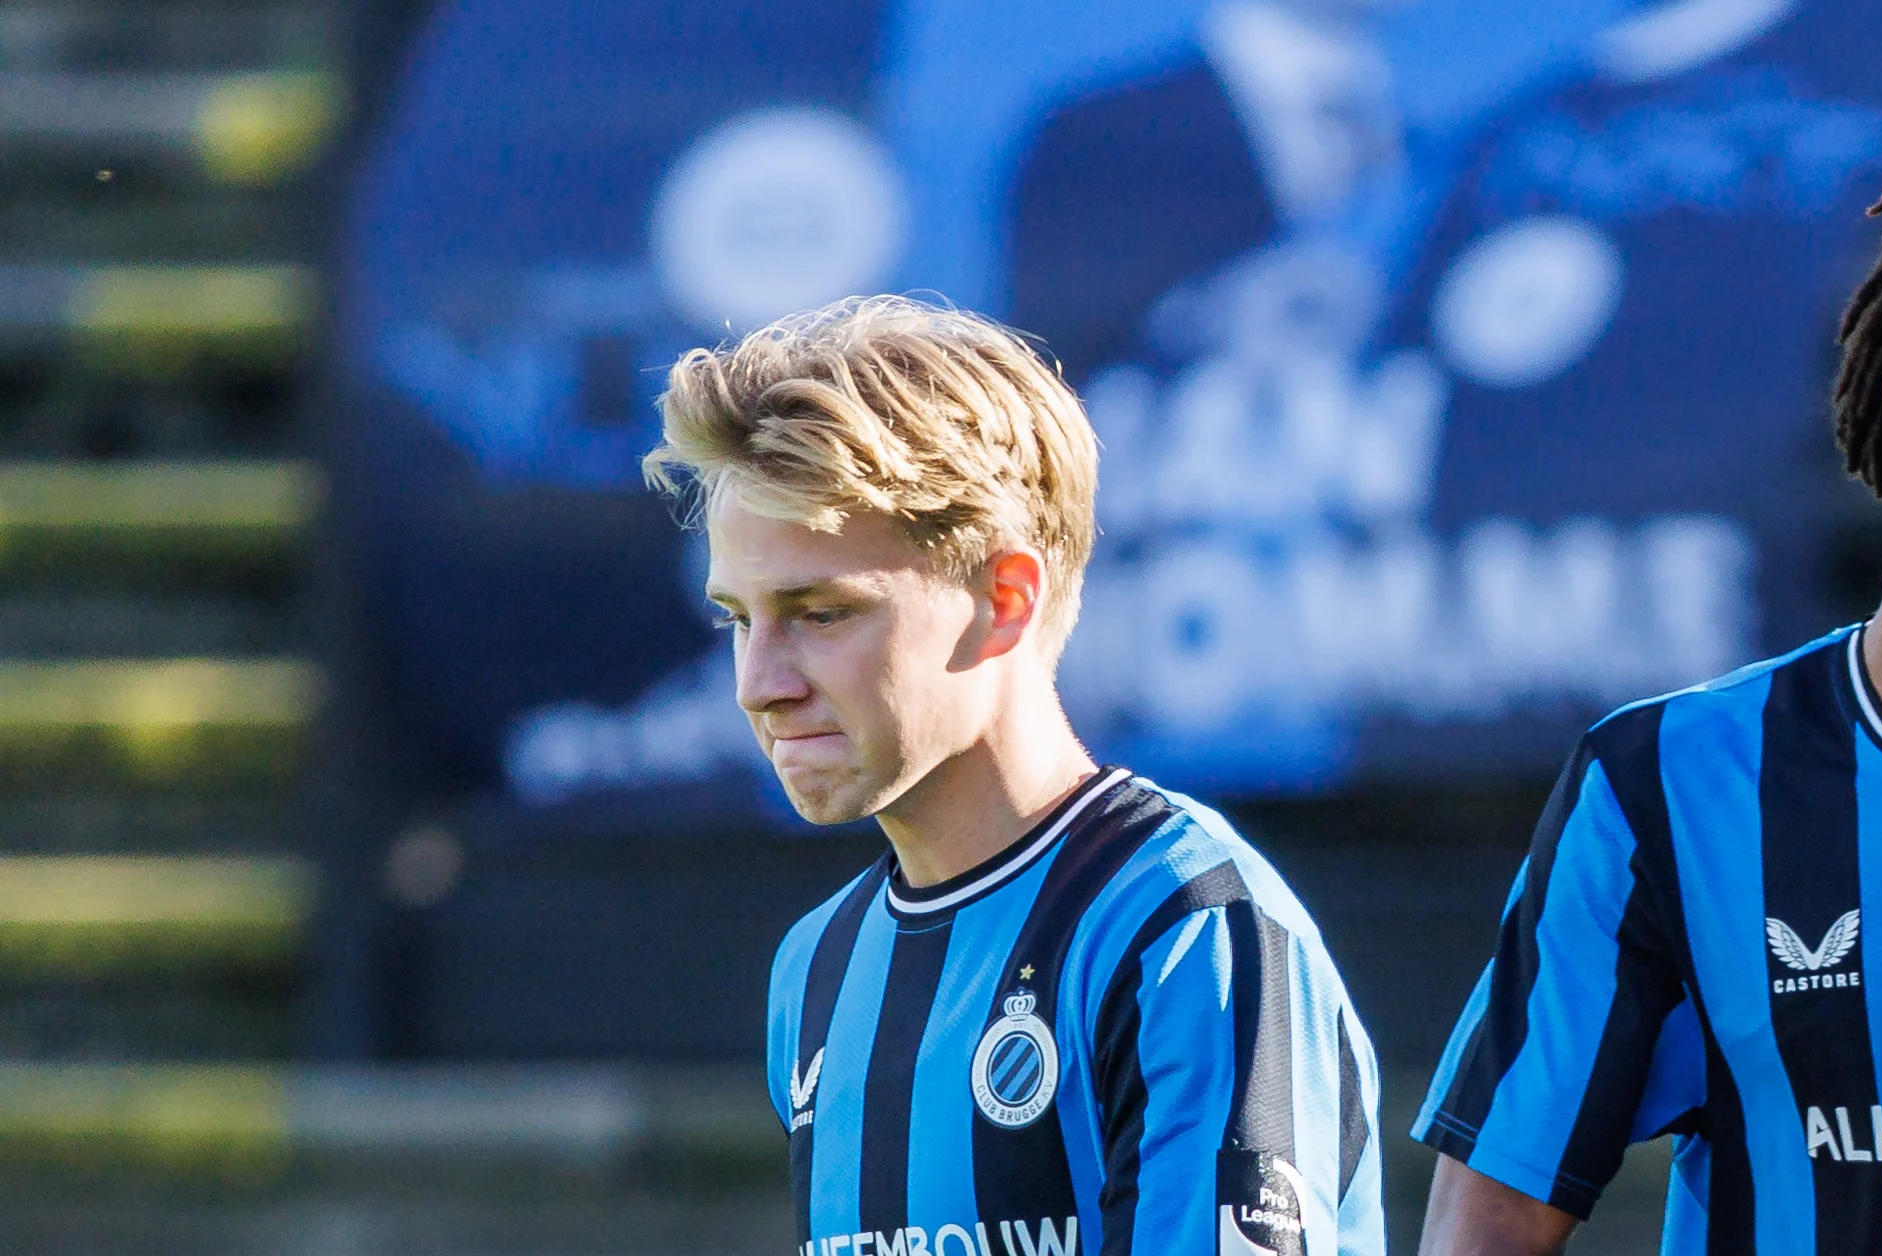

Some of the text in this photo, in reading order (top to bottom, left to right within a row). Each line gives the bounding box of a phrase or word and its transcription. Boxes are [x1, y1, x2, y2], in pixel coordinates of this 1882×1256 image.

[1773, 971, 1860, 994] CASTORE
[975, 1083, 998, 1115] CLUB
[998, 1100, 1043, 1122] BRUGGE
[1260, 1187, 1289, 1210] Pro
